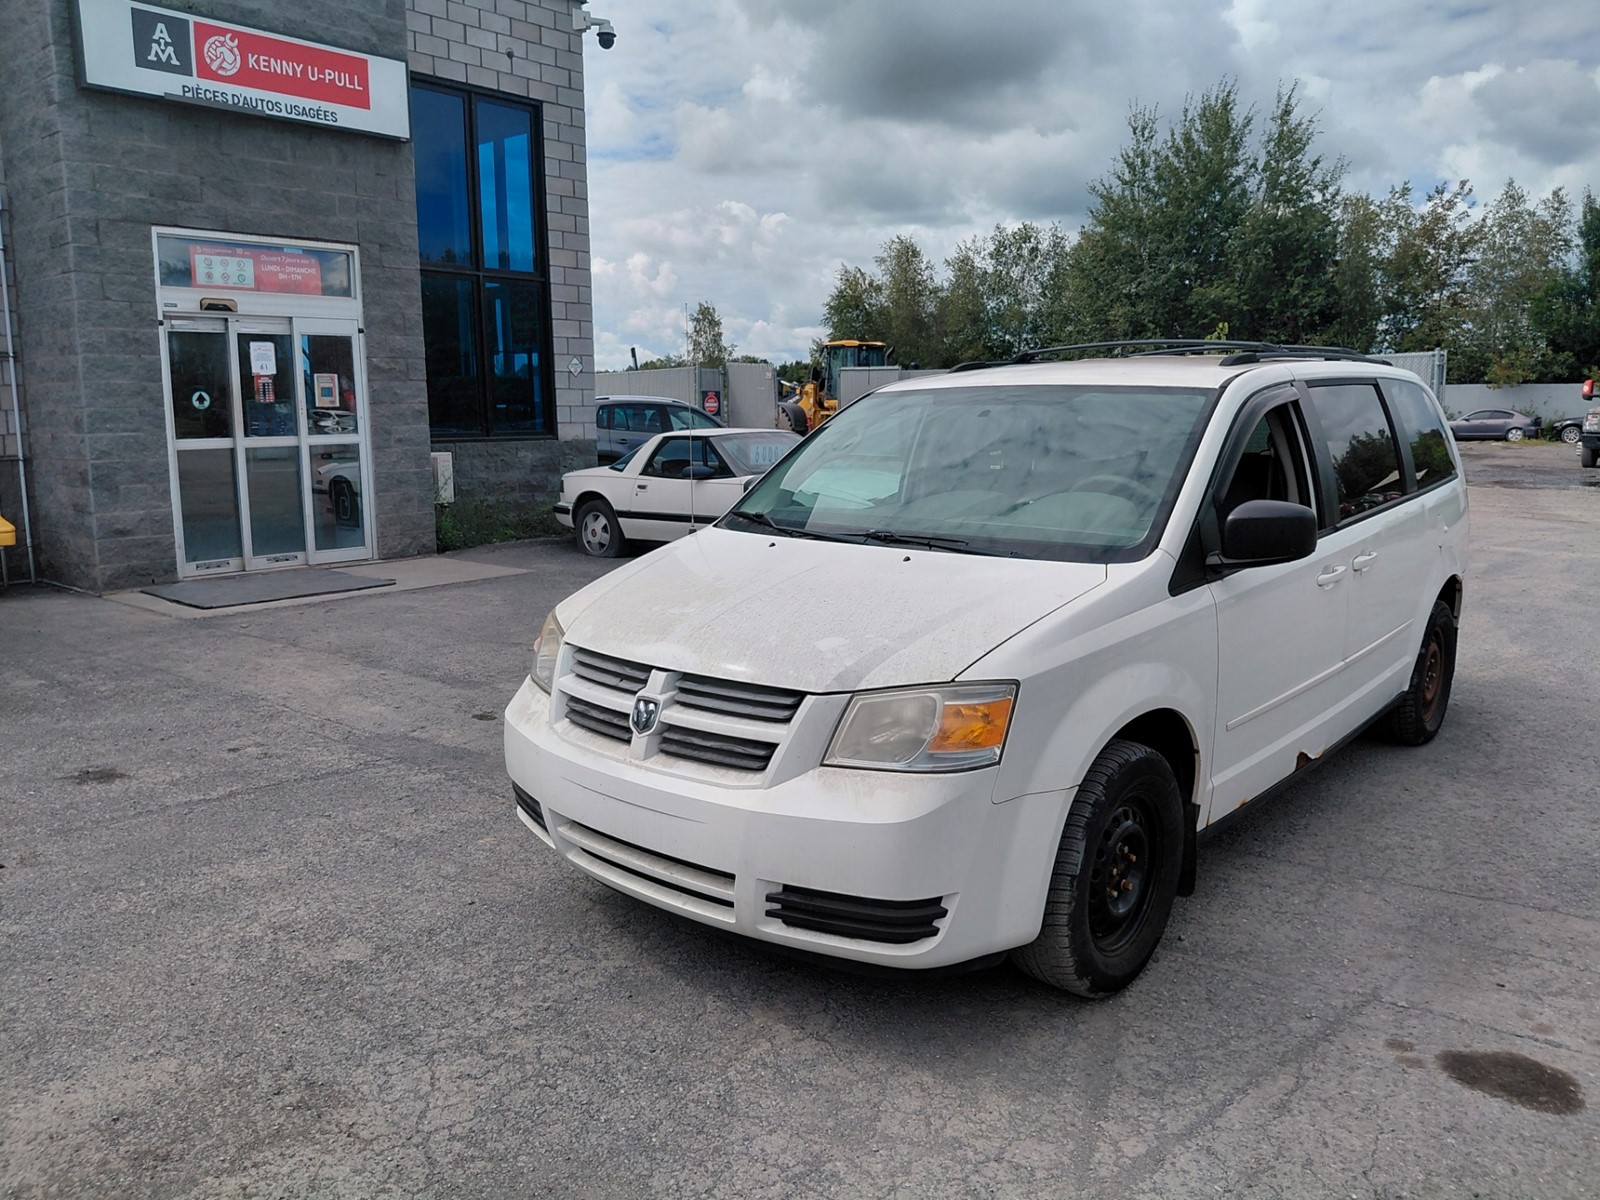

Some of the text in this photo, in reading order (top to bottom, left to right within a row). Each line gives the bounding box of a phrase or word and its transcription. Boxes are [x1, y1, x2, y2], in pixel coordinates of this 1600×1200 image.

[247, 53, 364, 91] KENNY U-PULL
[181, 83, 338, 123] PIÈCES D'AUTOS USAGÉES
[261, 264, 281, 272] LUNDI
[286, 266, 317, 274] DIMANCHE
